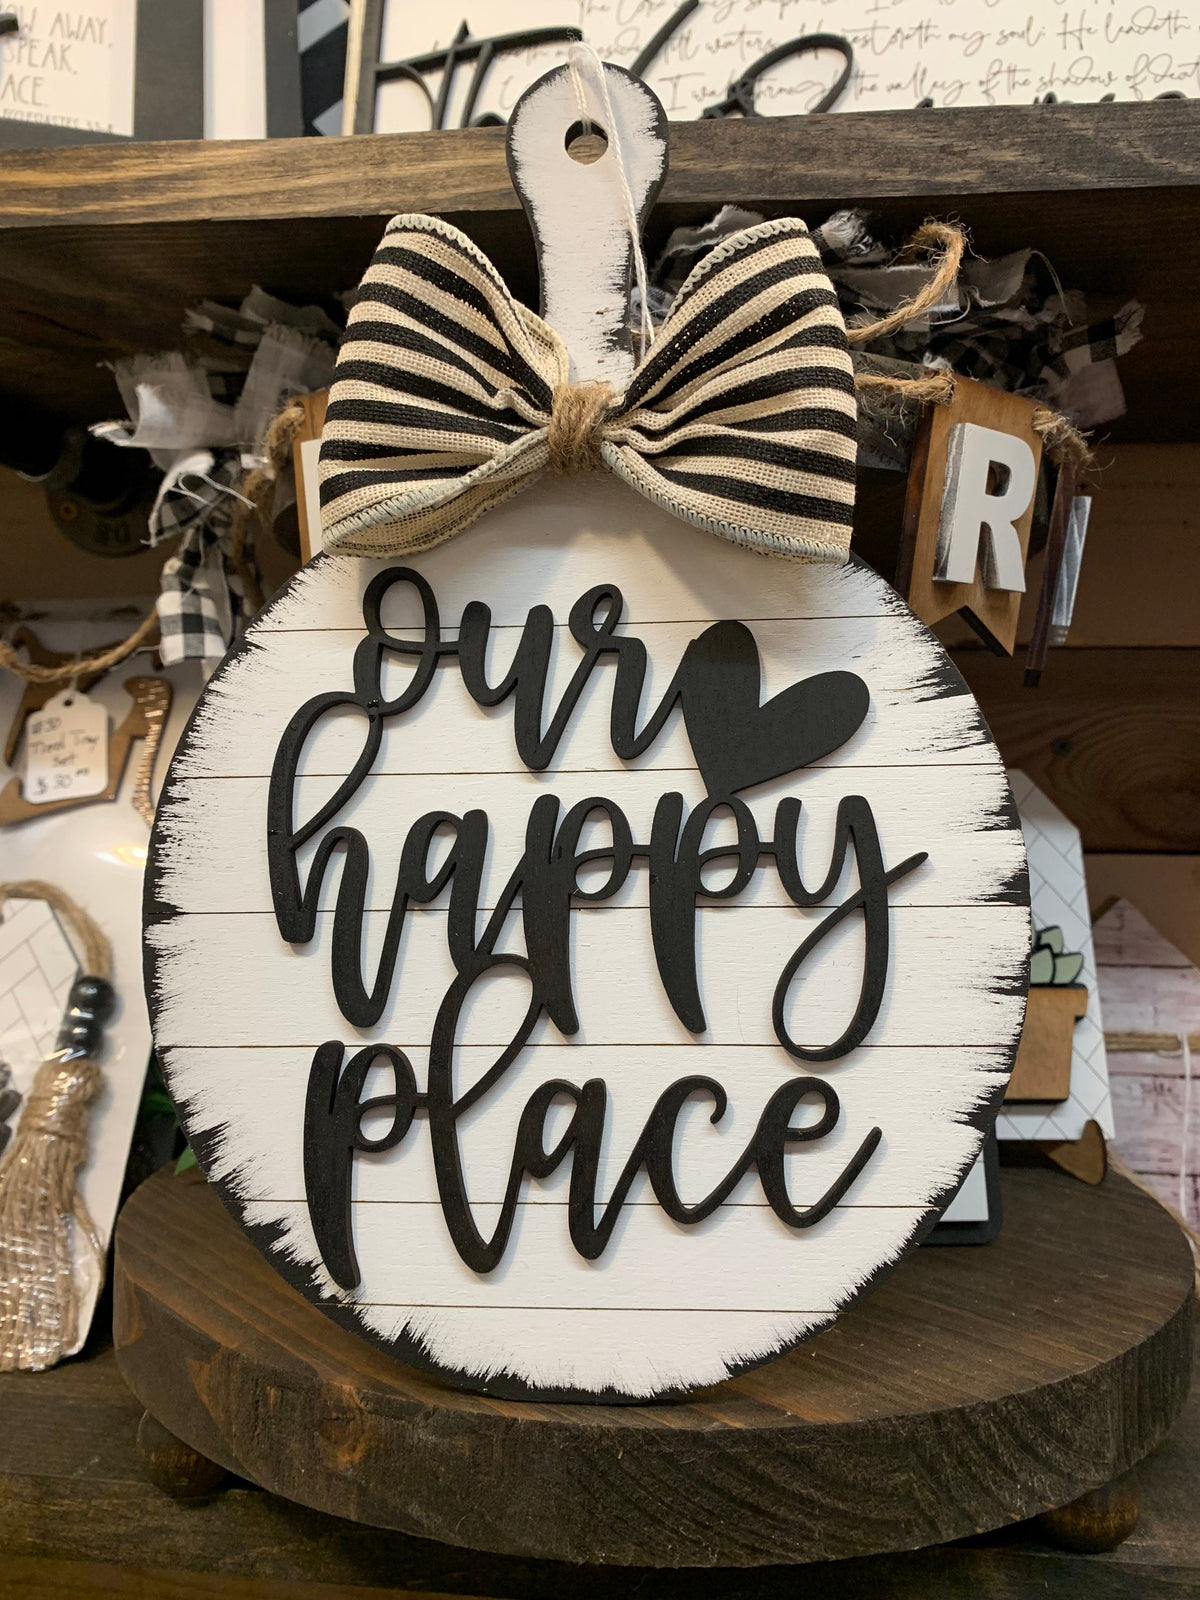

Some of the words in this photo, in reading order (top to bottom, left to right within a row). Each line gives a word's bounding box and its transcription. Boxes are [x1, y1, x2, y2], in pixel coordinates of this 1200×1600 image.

[933, 422, 1036, 593] R
[268, 691, 928, 1062] happy
[303, 954, 883, 1290] place
